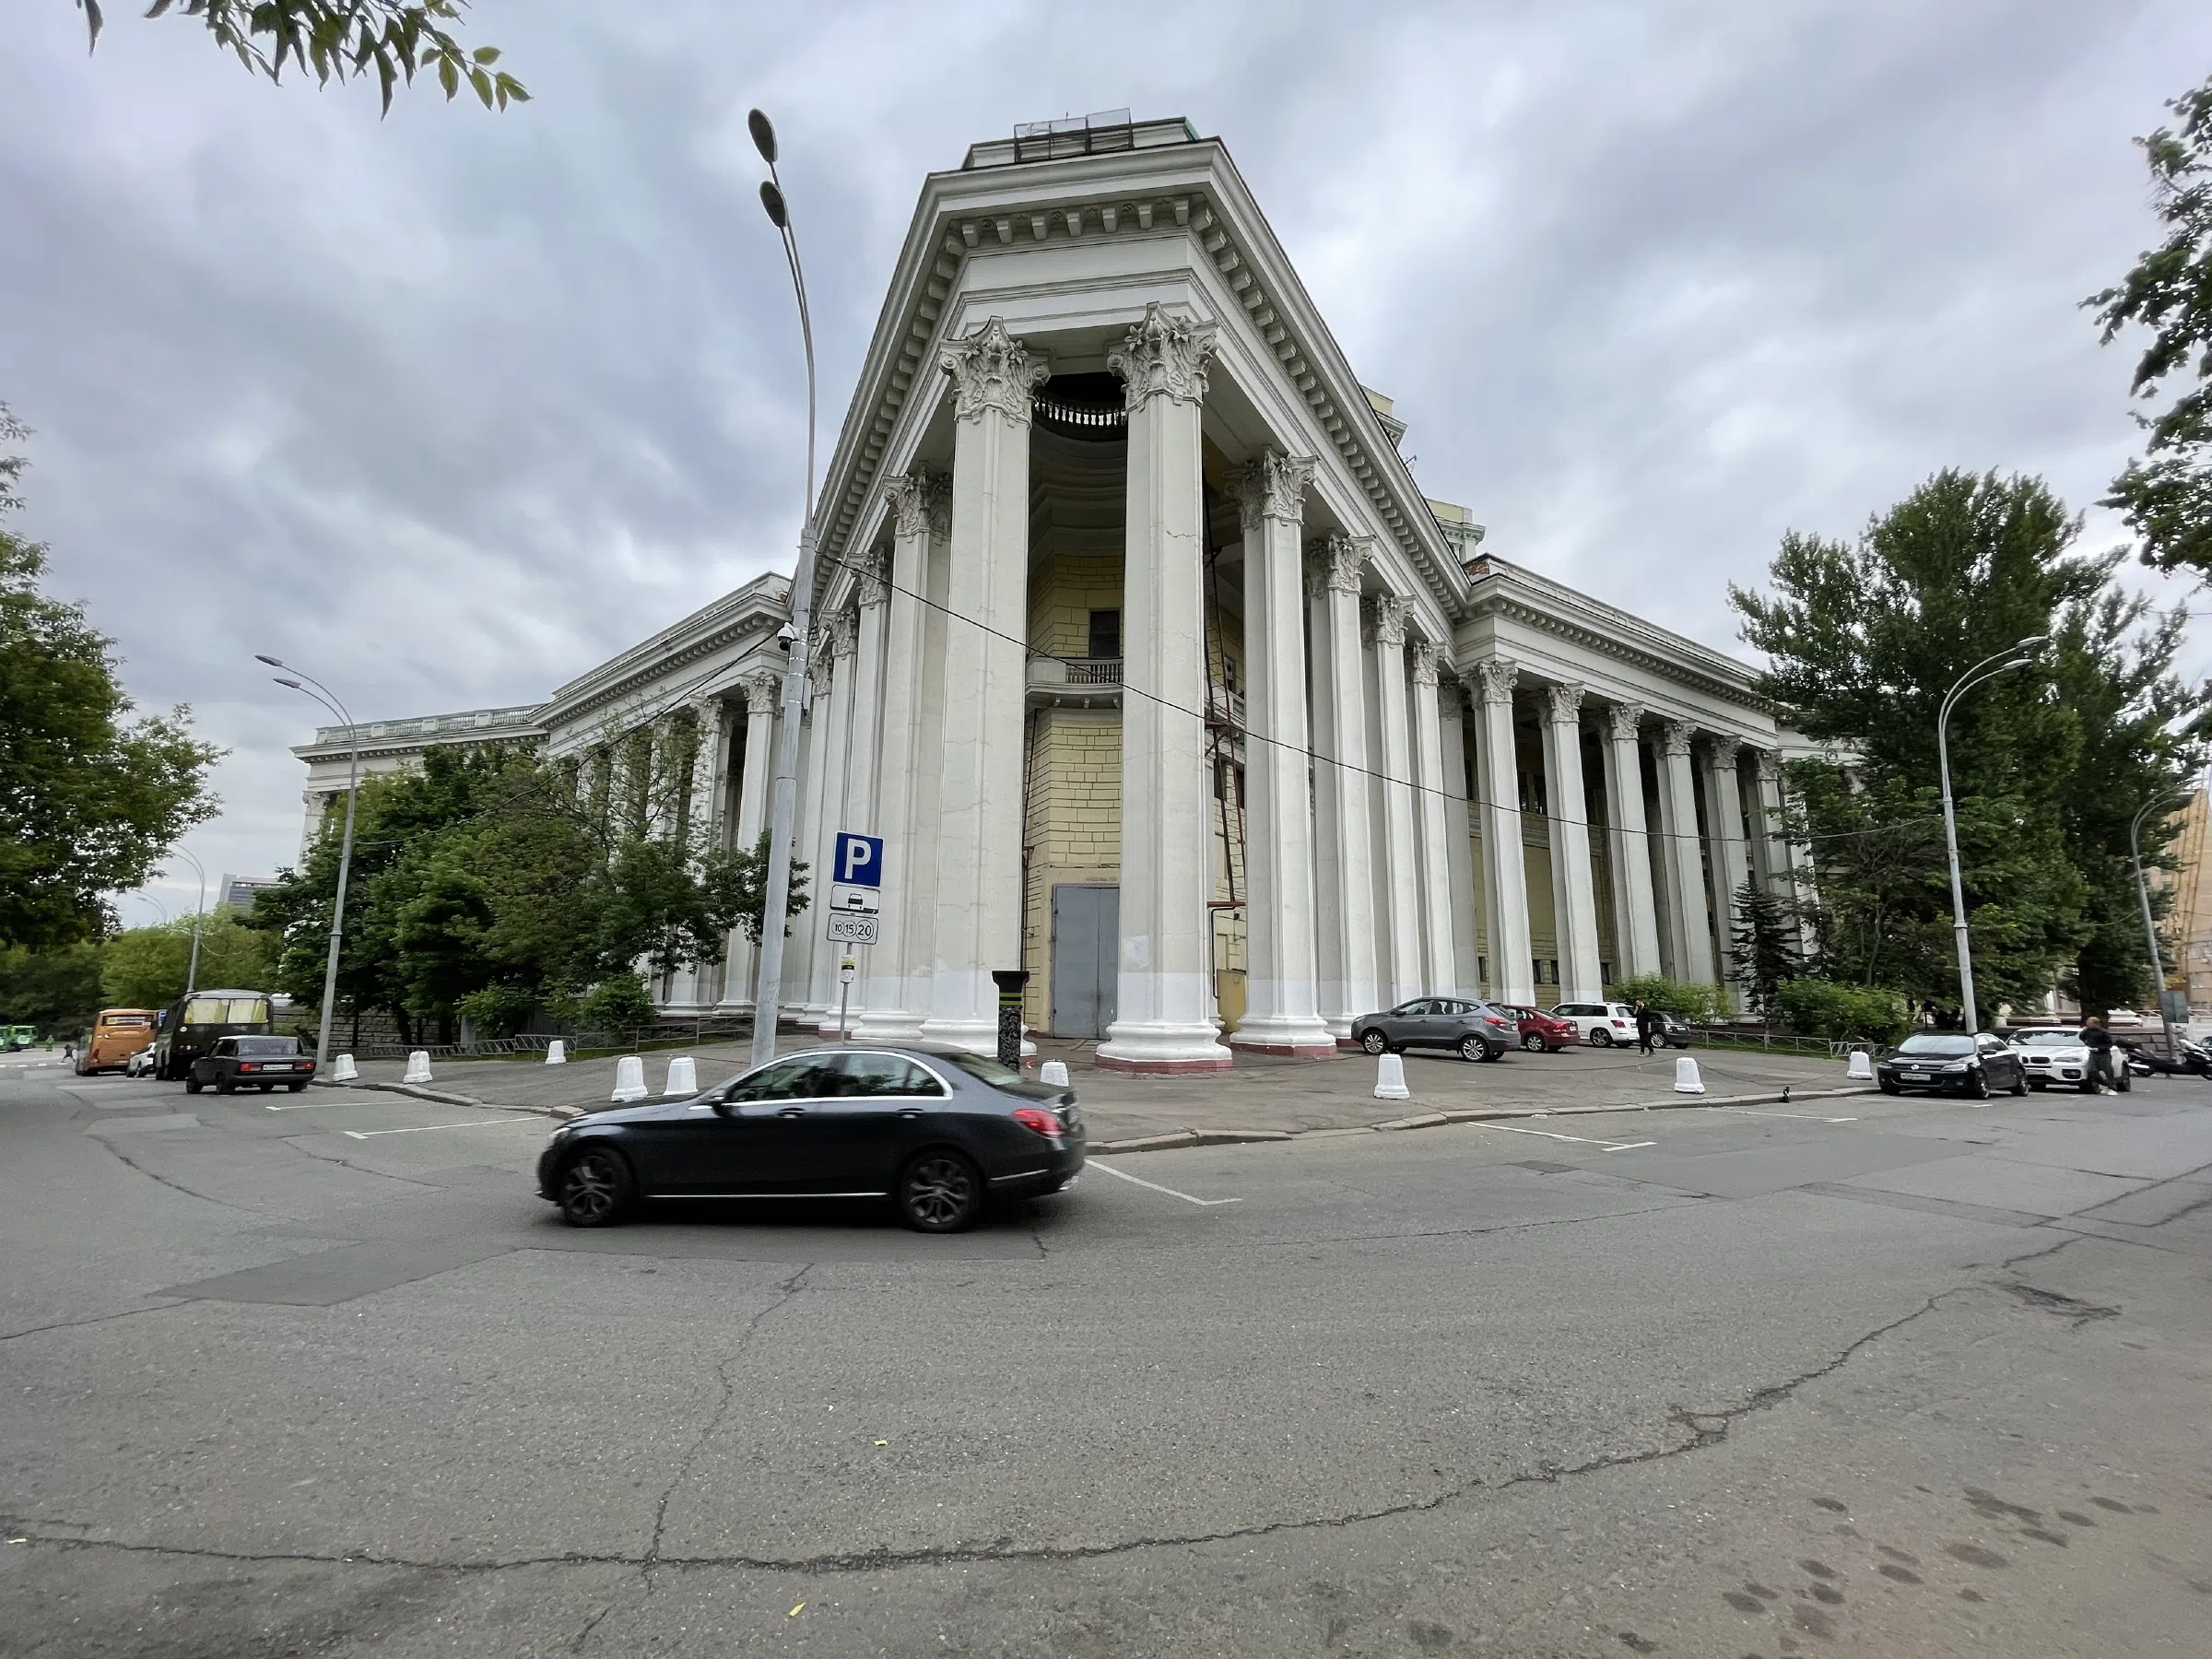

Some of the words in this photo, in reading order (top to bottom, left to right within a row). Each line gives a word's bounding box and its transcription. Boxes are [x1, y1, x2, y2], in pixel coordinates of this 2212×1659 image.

[844, 838, 872, 879] P
[834, 924, 842, 932] 10
[845, 924, 854, 934] 15
[857, 924, 872, 936] 20
